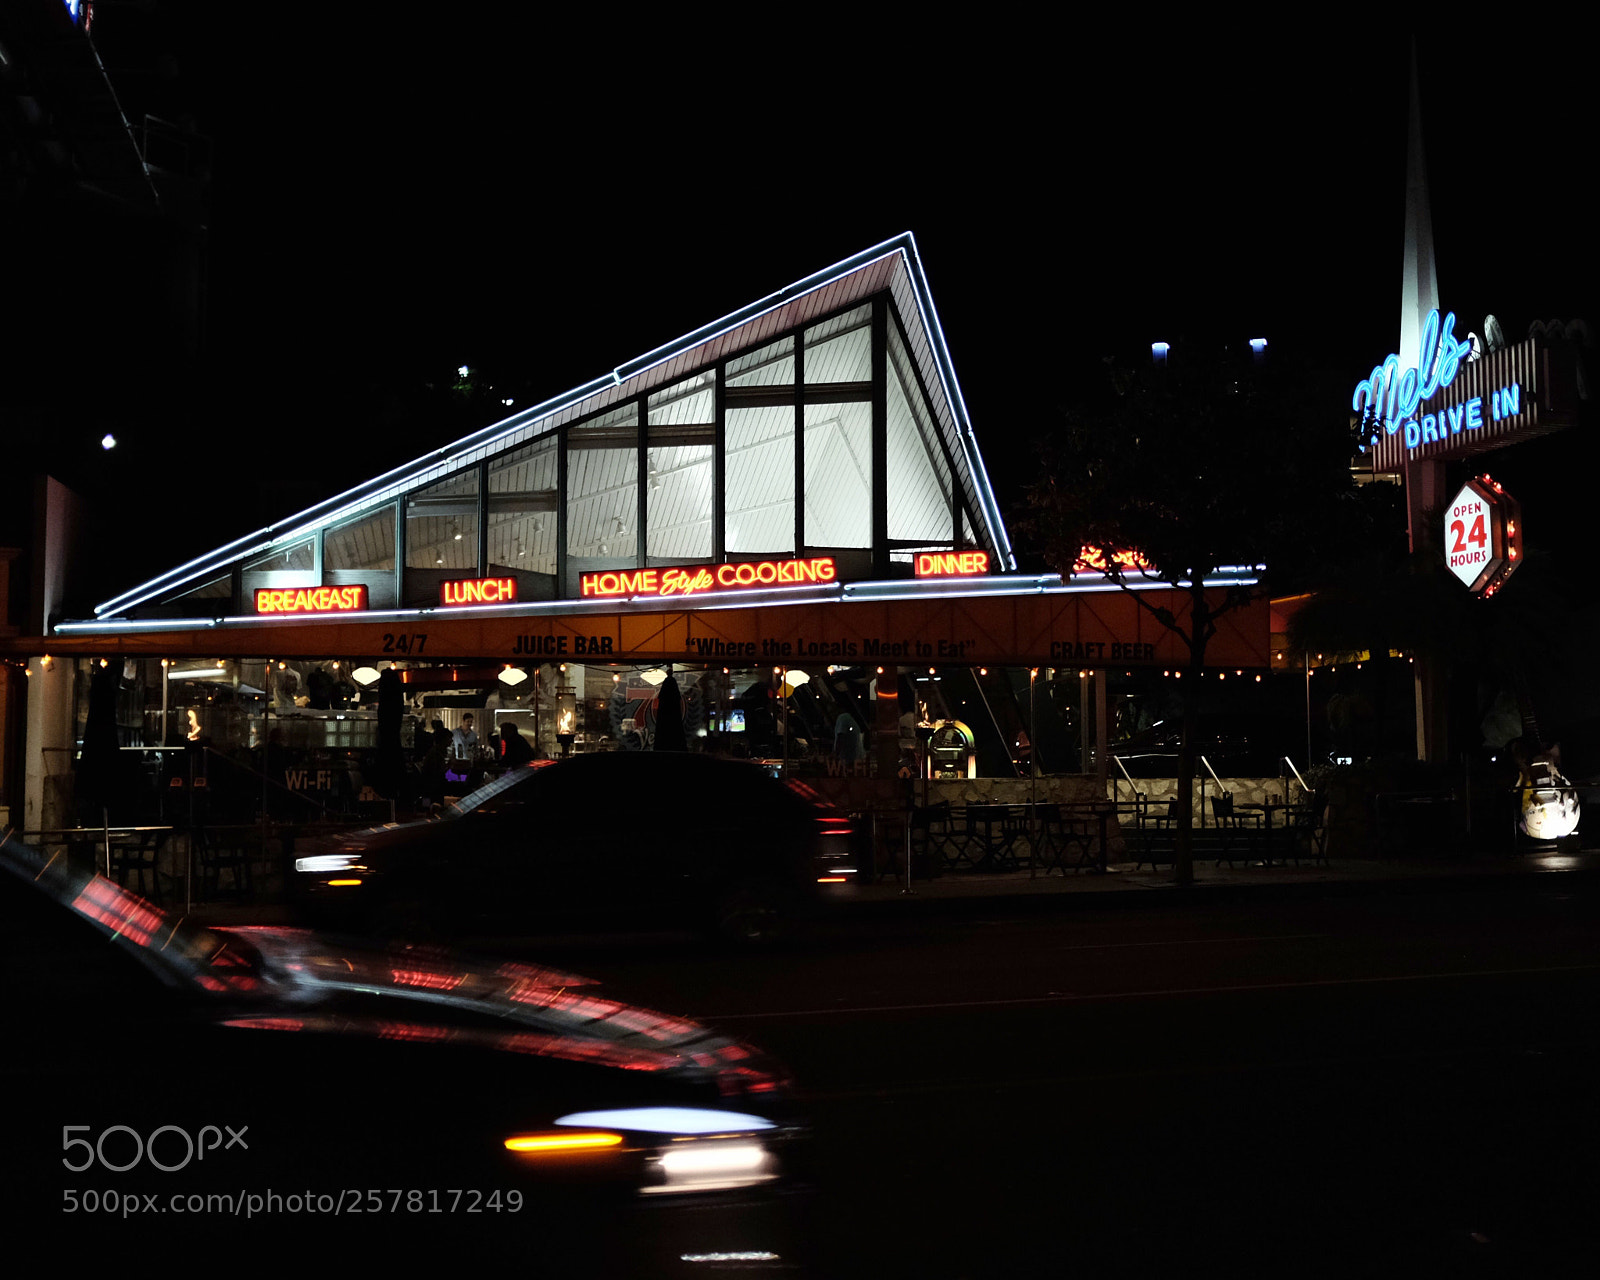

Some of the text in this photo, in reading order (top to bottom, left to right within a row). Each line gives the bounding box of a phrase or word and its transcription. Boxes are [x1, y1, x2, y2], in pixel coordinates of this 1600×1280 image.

[1405, 383, 1519, 449] DRIVE IN
[1453, 501, 1482, 518] OPEN
[1450, 514, 1487, 553] 24
[918, 552, 988, 575] DINNER
[1450, 550, 1486, 568] HOURS
[582, 558, 835, 596] HOME Style COOKING
[443, 579, 513, 604] LUNCH
[382, 634, 428, 653] 24/7
[513, 636, 613, 655] JUICE BAR
[763, 638, 792, 656] the
[798, 639, 858, 657] Locals
[863, 638, 910, 657] Meet
[915, 640, 932, 657] to
[1050, 641, 1154, 660] CRAFT BEER
[284, 769, 332, 792] Wi-Fi
